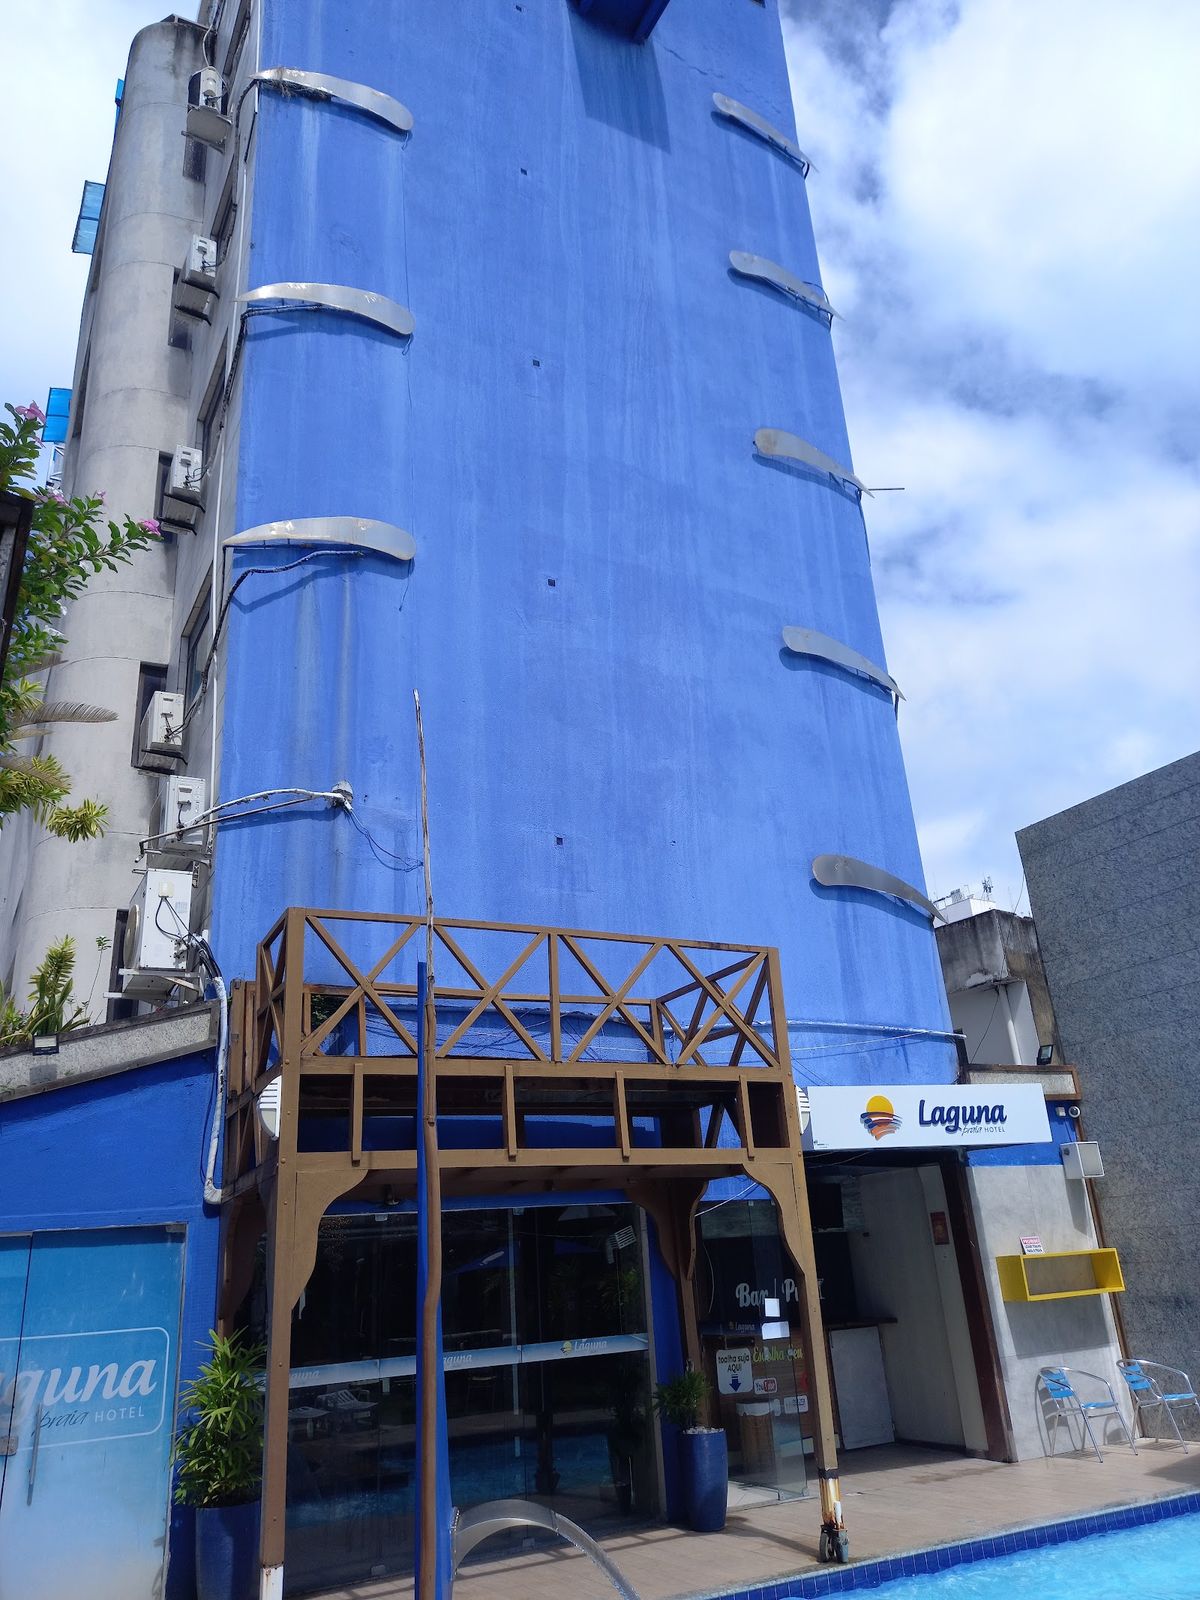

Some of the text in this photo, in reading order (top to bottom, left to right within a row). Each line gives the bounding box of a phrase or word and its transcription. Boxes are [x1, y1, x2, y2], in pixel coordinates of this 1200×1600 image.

[919, 1099, 1007, 1133] Laguna
[736, 1283, 769, 1308] Bar
[574, 1339, 608, 1353] Laguna
[727, 1363, 742, 1373] AQUI
[95, 1405, 145, 1423] HOTEL
